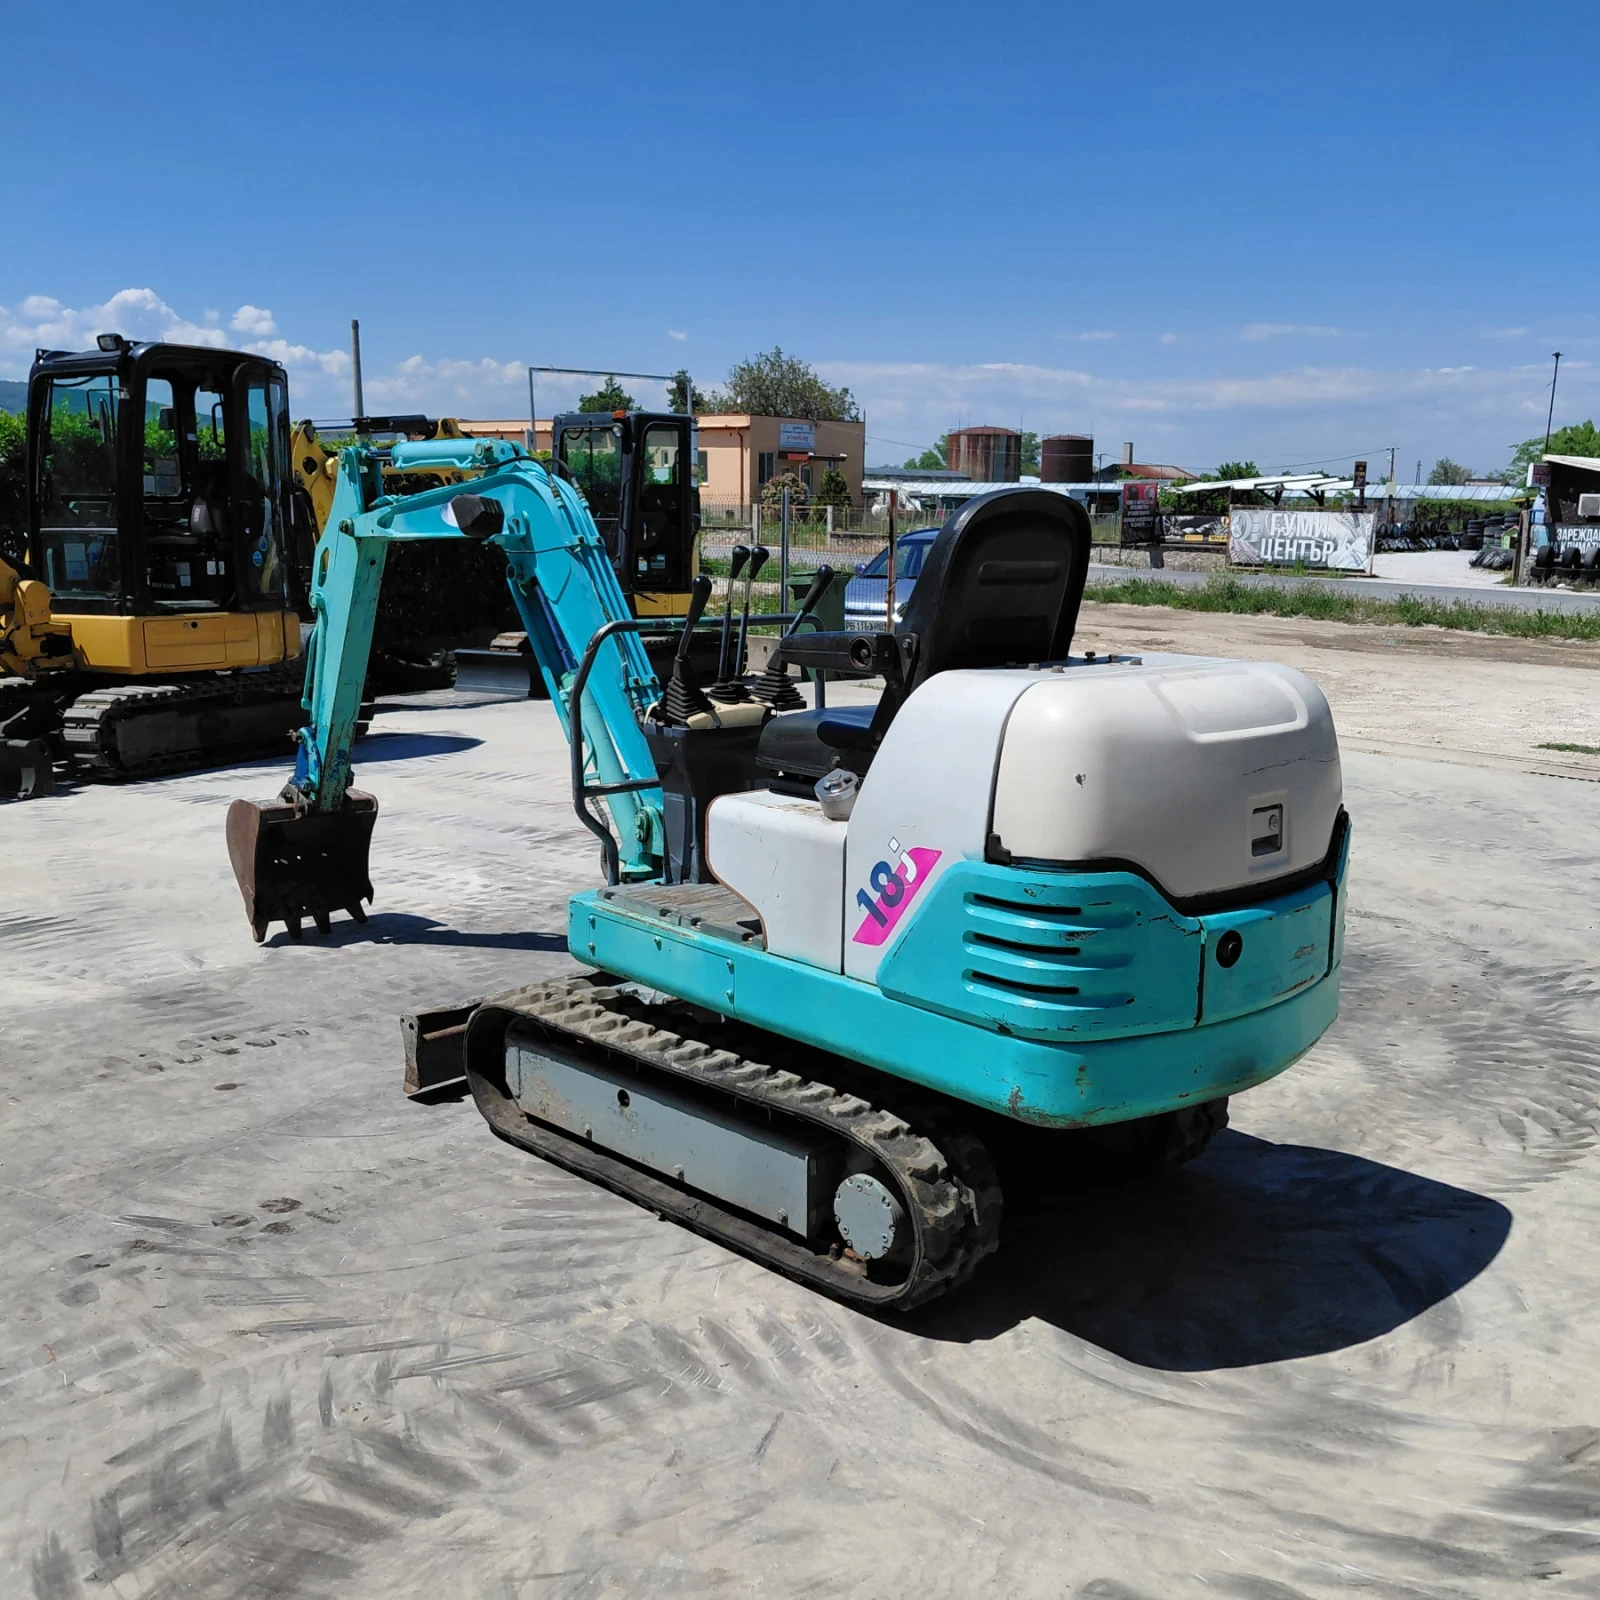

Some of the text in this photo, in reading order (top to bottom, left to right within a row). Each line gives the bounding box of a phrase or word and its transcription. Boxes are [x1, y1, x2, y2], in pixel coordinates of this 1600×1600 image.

[1270, 513, 1329, 538] ГУМИ
[1556, 528, 1600, 542] ЗАРЕЖДА
[1260, 538, 1335, 562] ЦЕНТЪР
